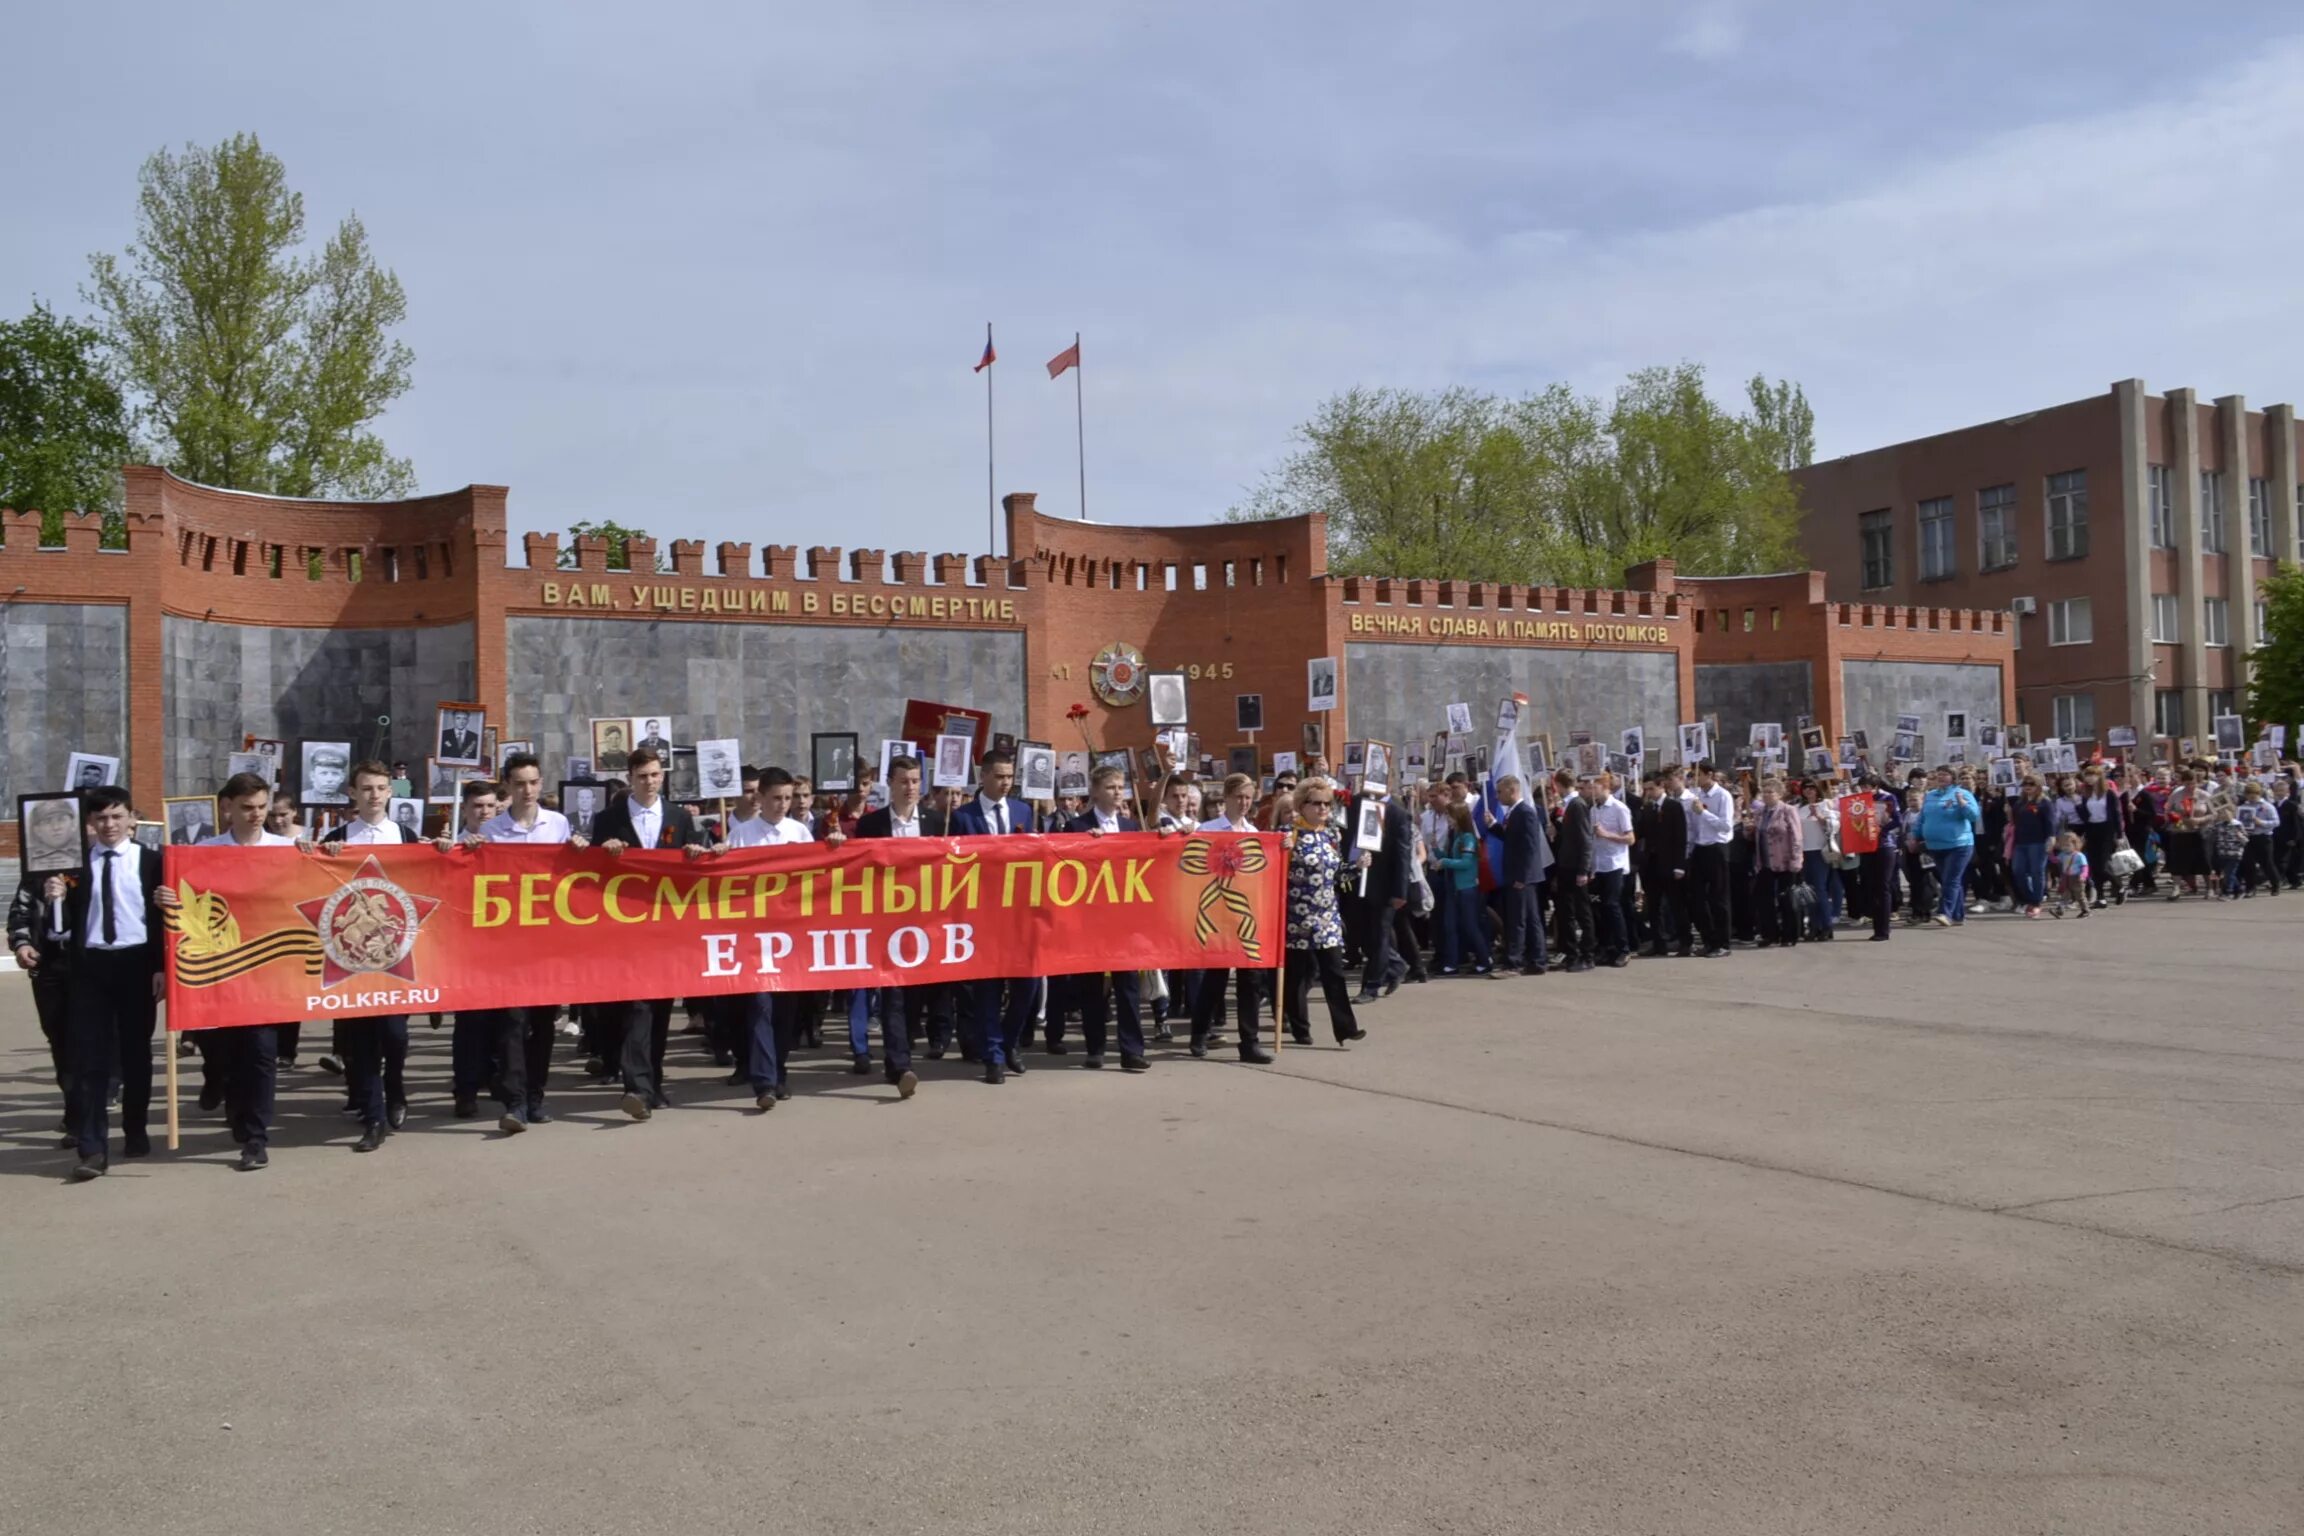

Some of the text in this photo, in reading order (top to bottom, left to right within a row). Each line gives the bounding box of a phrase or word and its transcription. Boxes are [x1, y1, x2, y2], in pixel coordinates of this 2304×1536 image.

[543, 582, 1020, 621] ВАМ, УШЕДШИМ В БЕССМЕРТИЕ,
[1352, 614, 1668, 643] ВЕЧНАЯ СЛАВА И ПАМЯТЬ ПОТОМКОВ
[473, 853, 1154, 928] БЕССМЕРТНЫЙ ПОЛК
[701, 922, 976, 977] ЕРШОВ
[306, 987, 440, 1012] POLKRF.RU
